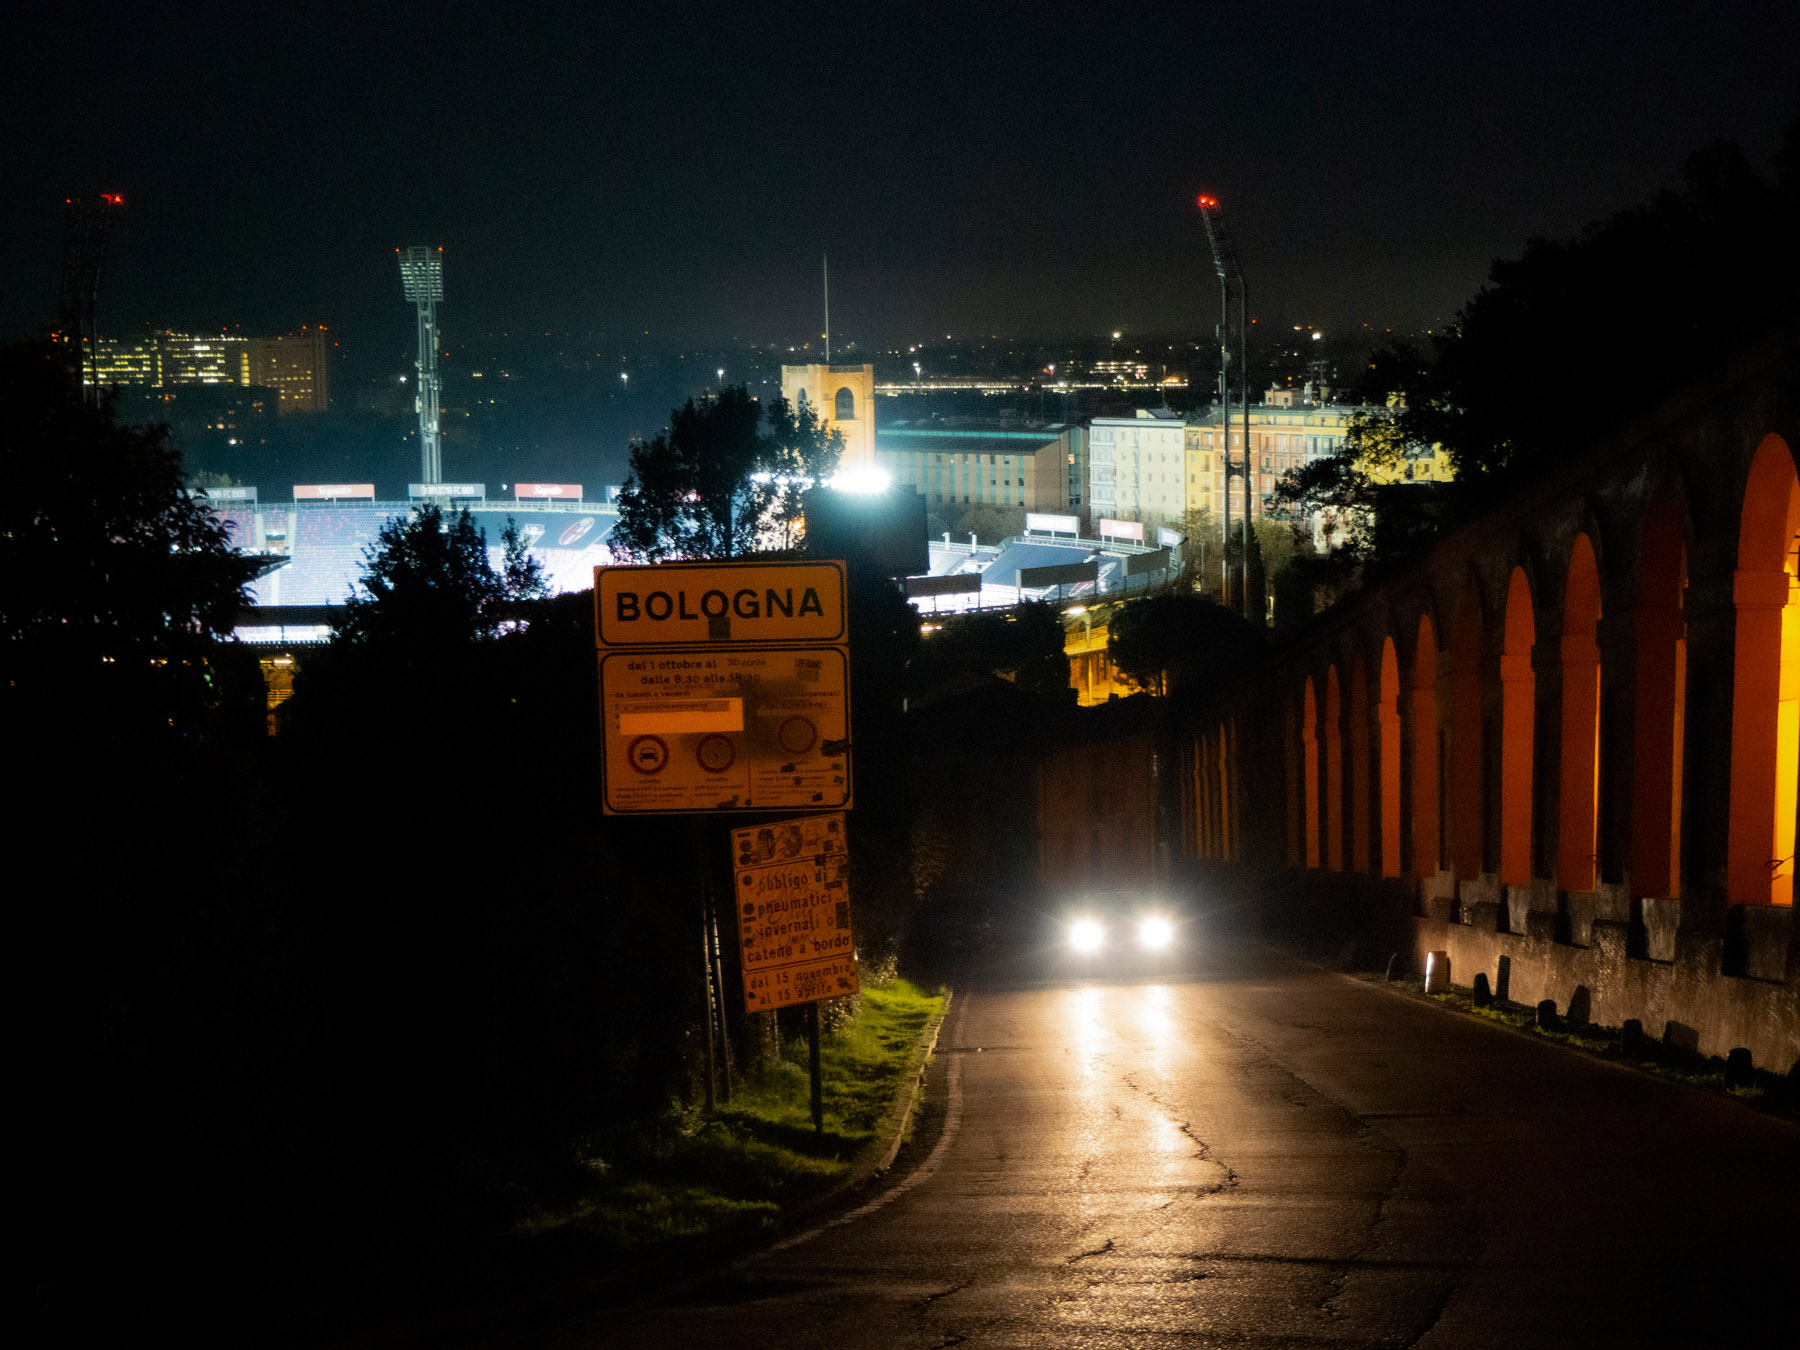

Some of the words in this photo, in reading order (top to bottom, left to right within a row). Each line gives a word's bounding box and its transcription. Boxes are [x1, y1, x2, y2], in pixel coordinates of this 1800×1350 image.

[616, 588, 824, 621] BOLOGNA
[627, 661, 646, 671] dal
[650, 661, 655, 670] 1
[658, 660, 702, 670] ottobre
[706, 659, 717, 669] al
[640, 674, 670, 685] dalle
[703, 673, 726, 684] alle
[758, 893, 833, 916] pneumatici
[747, 945, 793, 963] catene
[799, 943, 806, 954] a
[814, 935, 850, 952] bordo
[750, 974, 770, 989] dal
[776, 971, 788, 984] 15
[760, 990, 770, 1004] al
[778, 988, 790, 1001] 15
